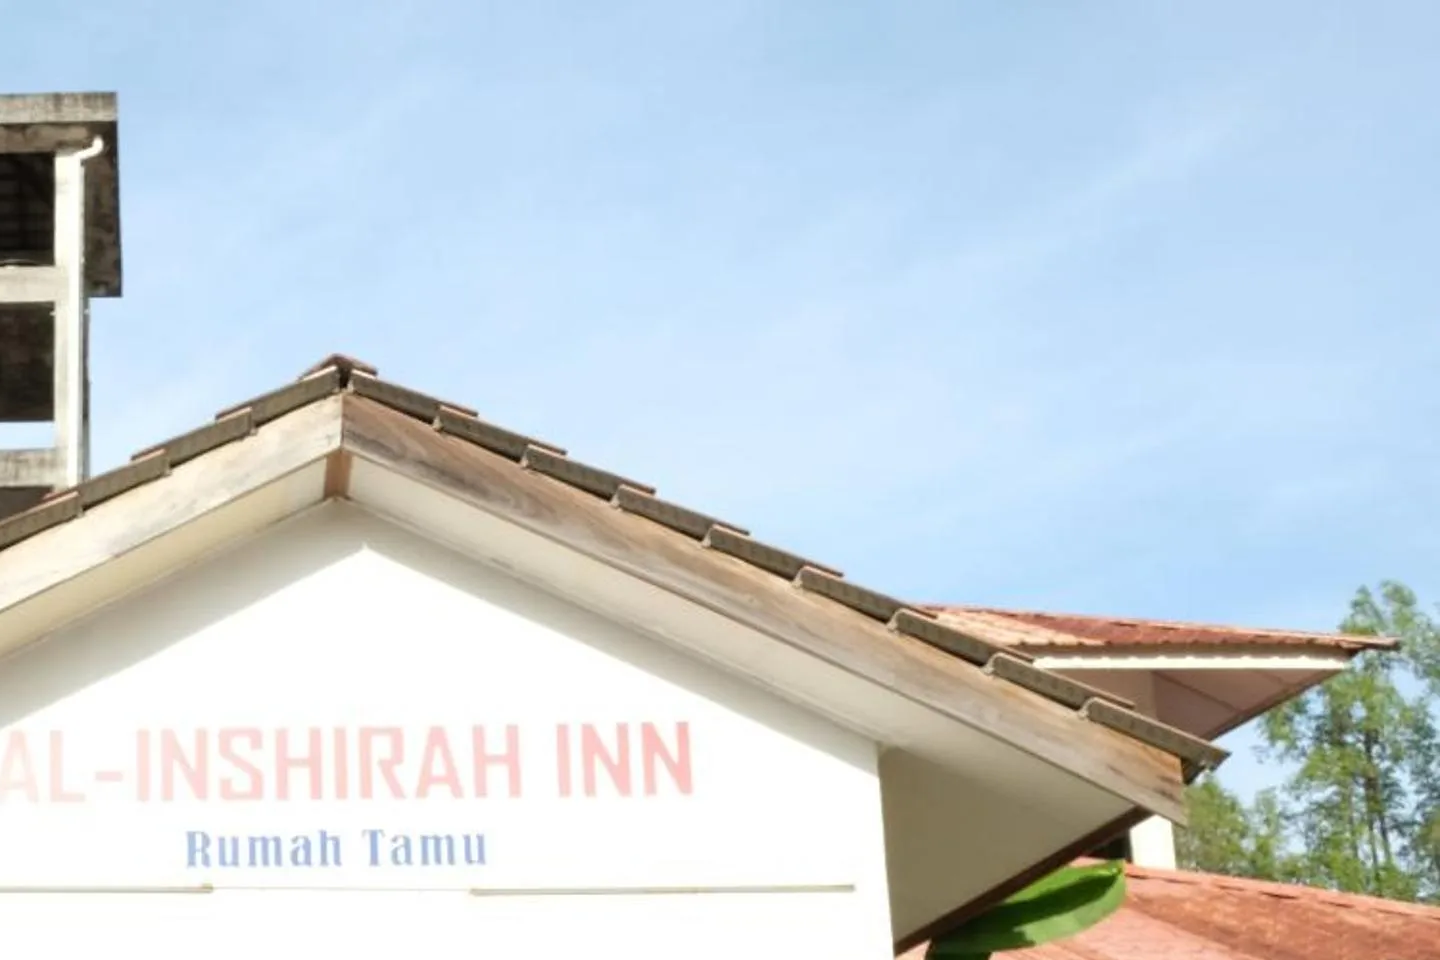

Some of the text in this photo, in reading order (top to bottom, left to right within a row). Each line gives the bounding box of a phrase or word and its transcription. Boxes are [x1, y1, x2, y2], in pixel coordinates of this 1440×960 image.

[557, 722, 694, 797] INN
[185, 829, 487, 868] Rumah Tamu
